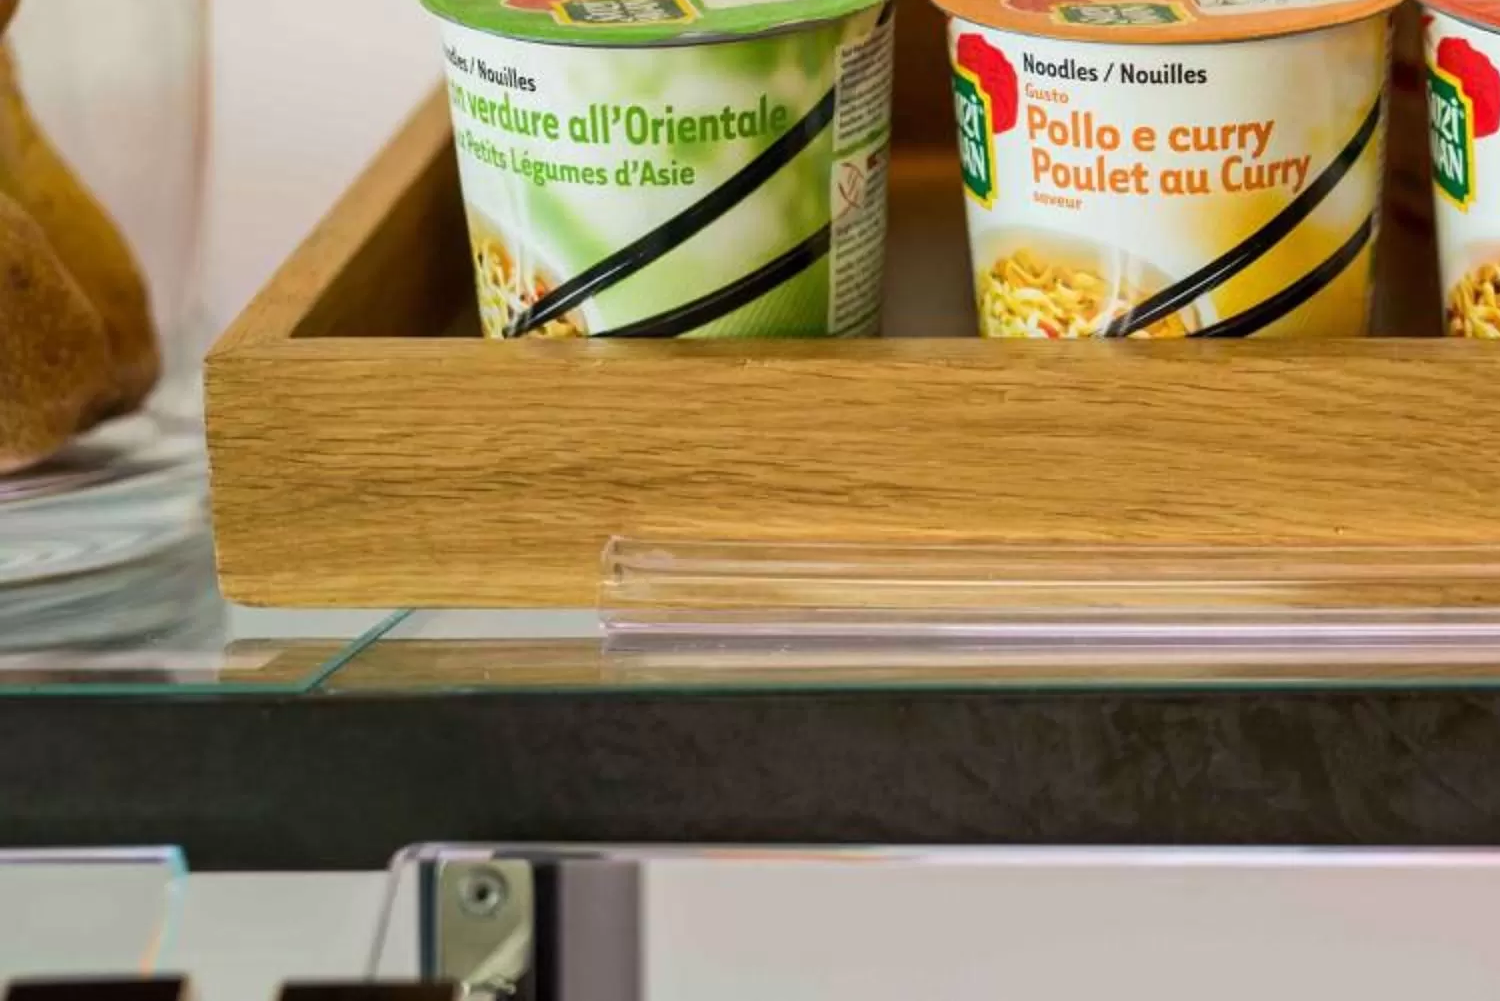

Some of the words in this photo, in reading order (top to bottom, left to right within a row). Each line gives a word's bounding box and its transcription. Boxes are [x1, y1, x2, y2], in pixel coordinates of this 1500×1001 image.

[477, 59, 537, 92] Nouilles
[1023, 52, 1099, 82] Noodles
[1121, 62, 1208, 84] Nouilles
[1025, 82, 1069, 104] Gusto
[468, 90, 560, 140] verdure
[568, 94, 788, 146] all'Orientale
[1027, 103, 1121, 152] Pollo
[1132, 125, 1156, 152] e
[1168, 119, 1275, 159] curry
[511, 148, 608, 186] Légumes
[615, 159, 696, 186] d'Asie
[1031, 146, 1150, 194] Poulet
[1159, 168, 1212, 196] au
[1221, 154, 1312, 194] Curry
